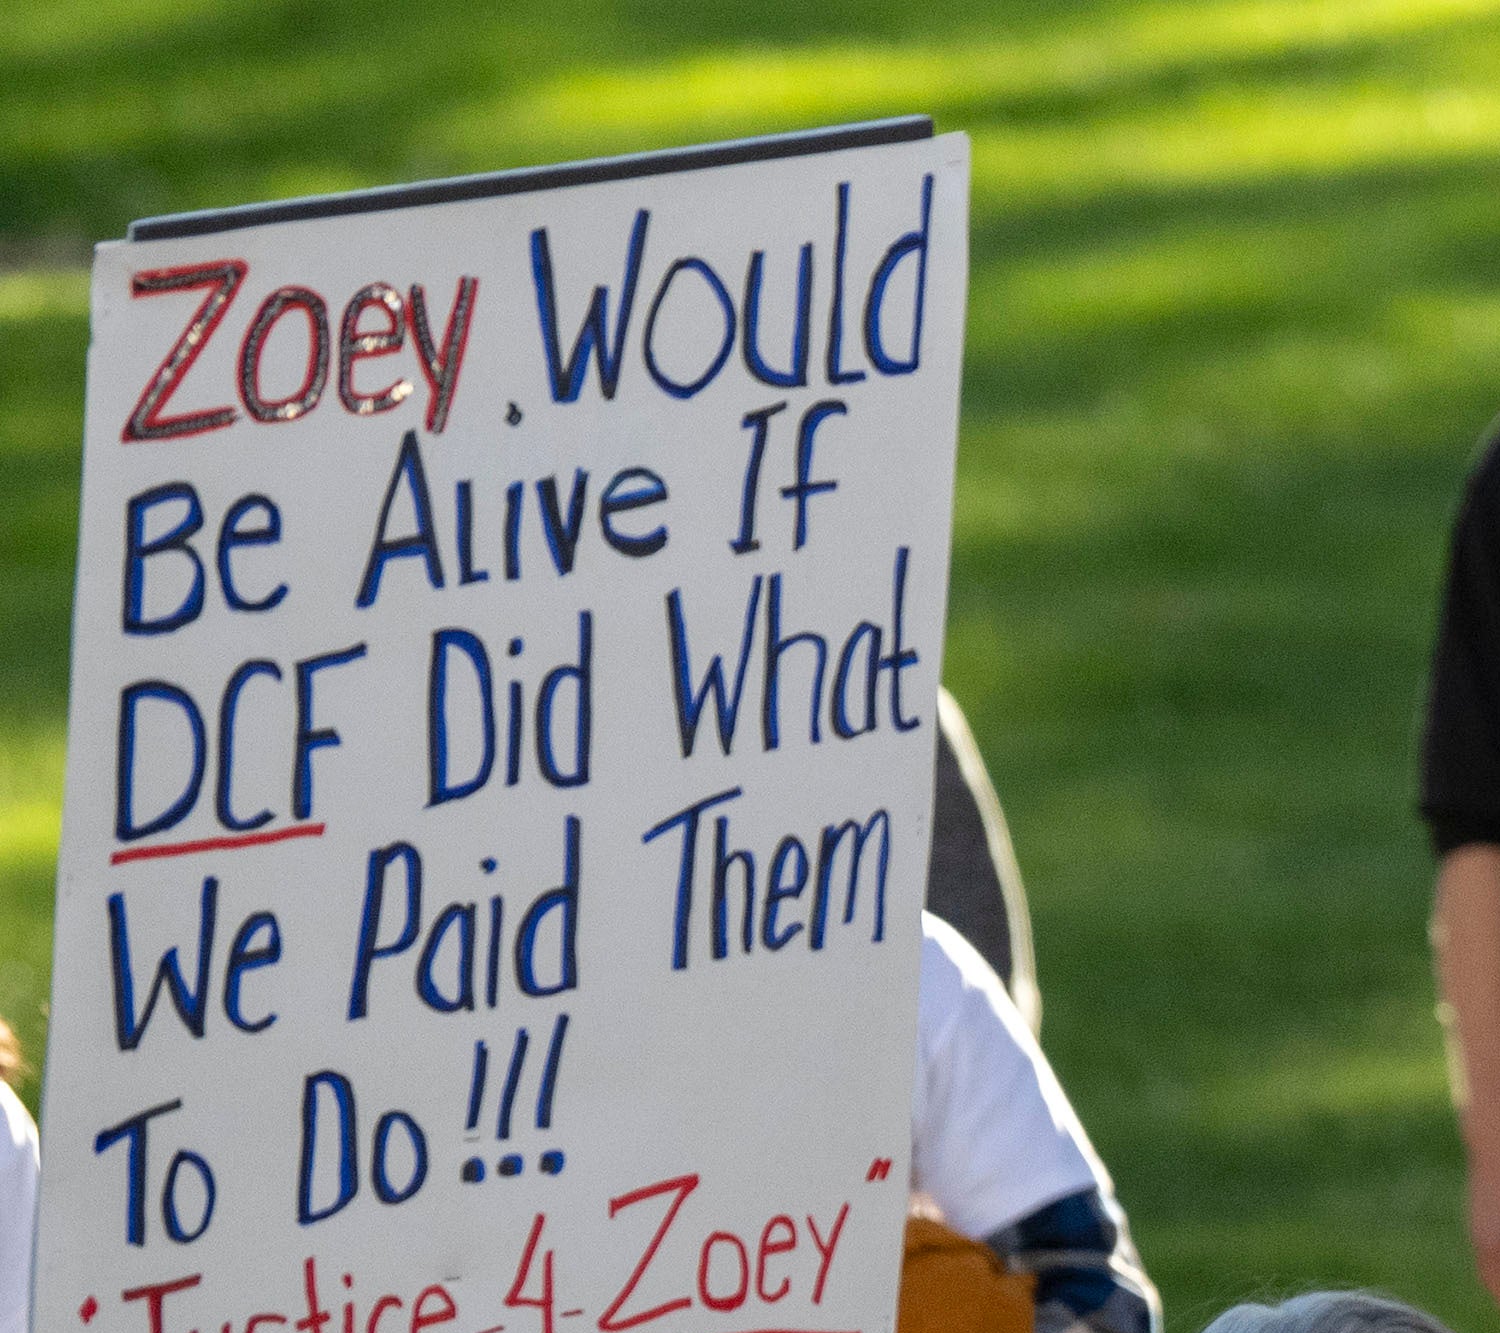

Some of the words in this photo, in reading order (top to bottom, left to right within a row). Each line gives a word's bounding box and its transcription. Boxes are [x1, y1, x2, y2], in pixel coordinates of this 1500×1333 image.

[529, 174, 934, 406] Would
[122, 481, 289, 635] Be
[729, 400, 848, 554] If
[113, 643, 369, 844] DCF
[424, 610, 594, 808] Did
[666, 545, 921, 759] What
[107, 876, 283, 1052] We
[346, 814, 581, 1022] Paid
[642, 785, 891, 970] Them
[93, 1097, 216, 1247] To
